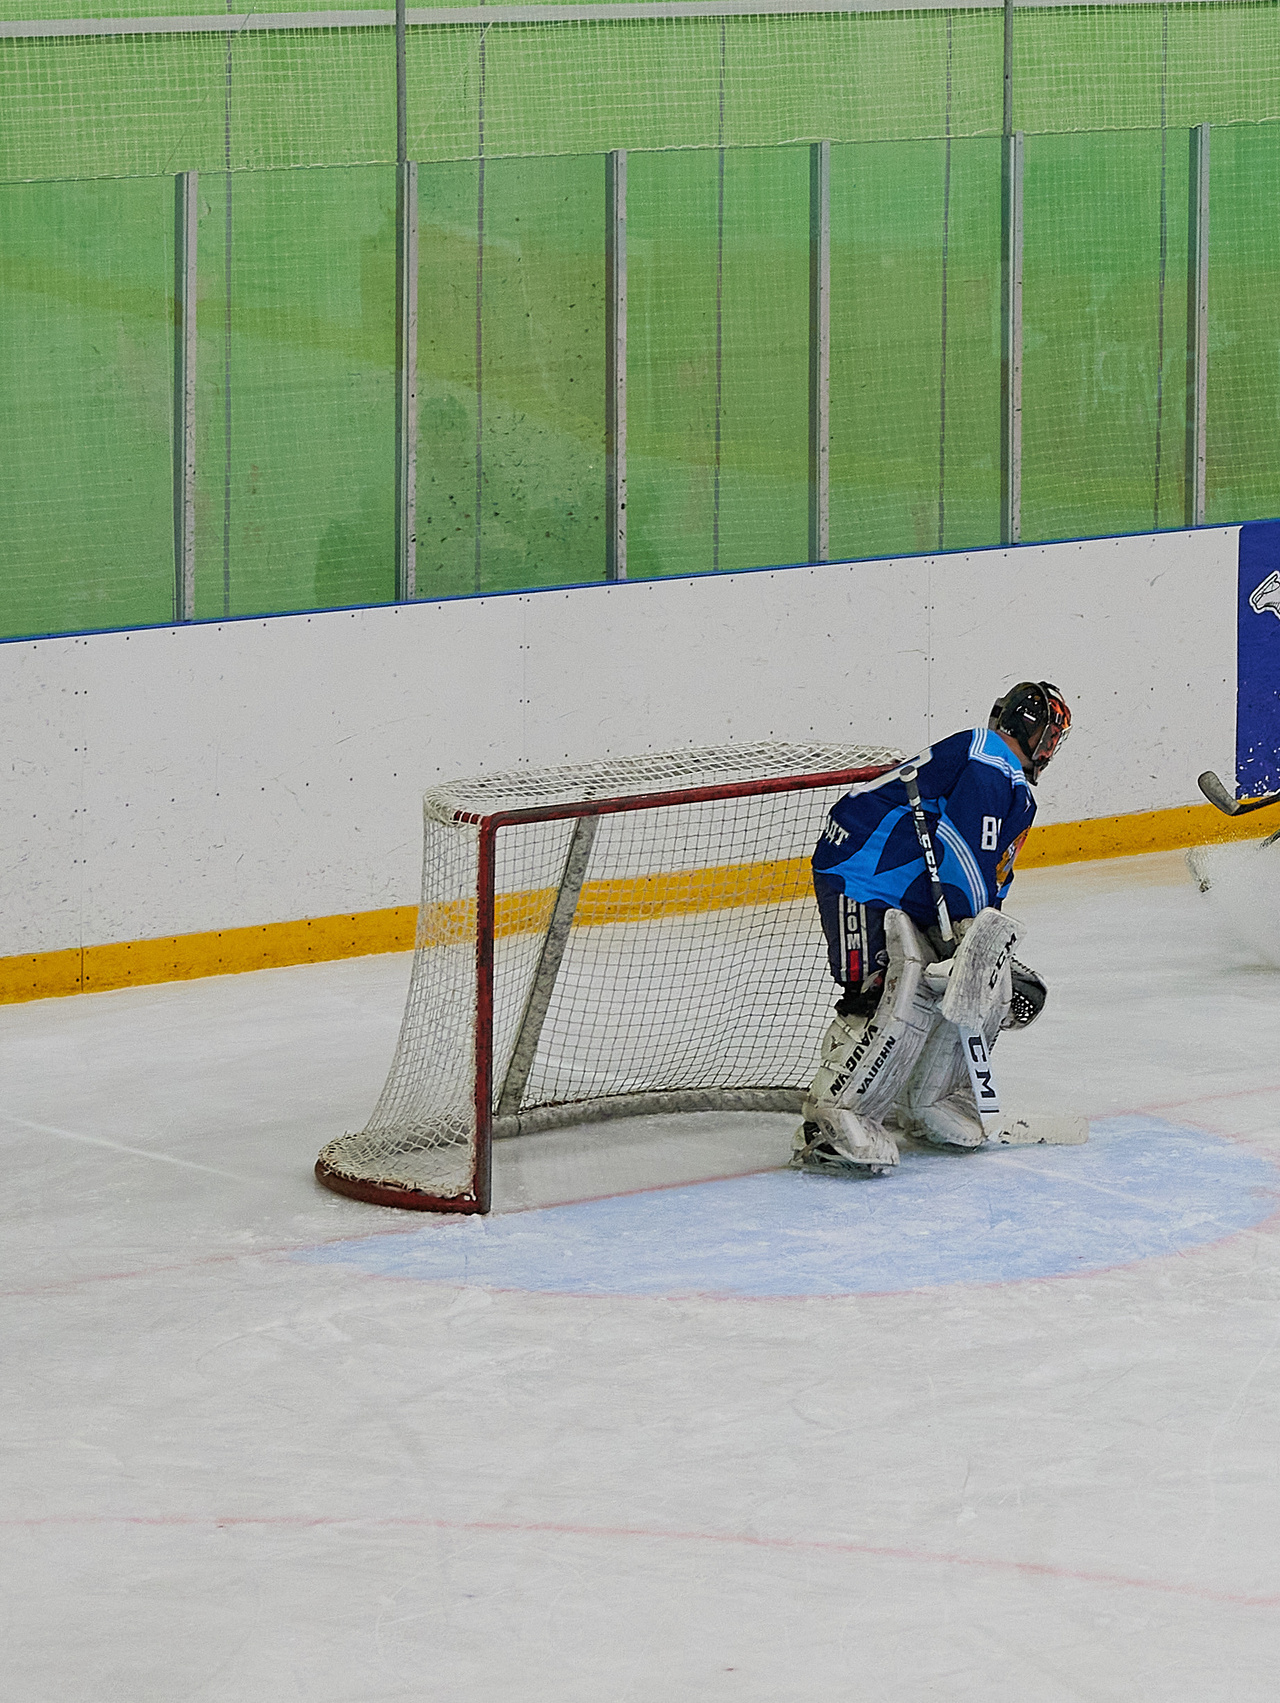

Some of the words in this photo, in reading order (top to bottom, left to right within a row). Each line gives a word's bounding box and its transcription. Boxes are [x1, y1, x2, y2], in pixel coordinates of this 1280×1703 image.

[921, 833, 940, 882] CCM
[981, 815, 1002, 851] 8
[856, 1035, 896, 1095] VAUGHN
[967, 1036, 997, 1098] CM
